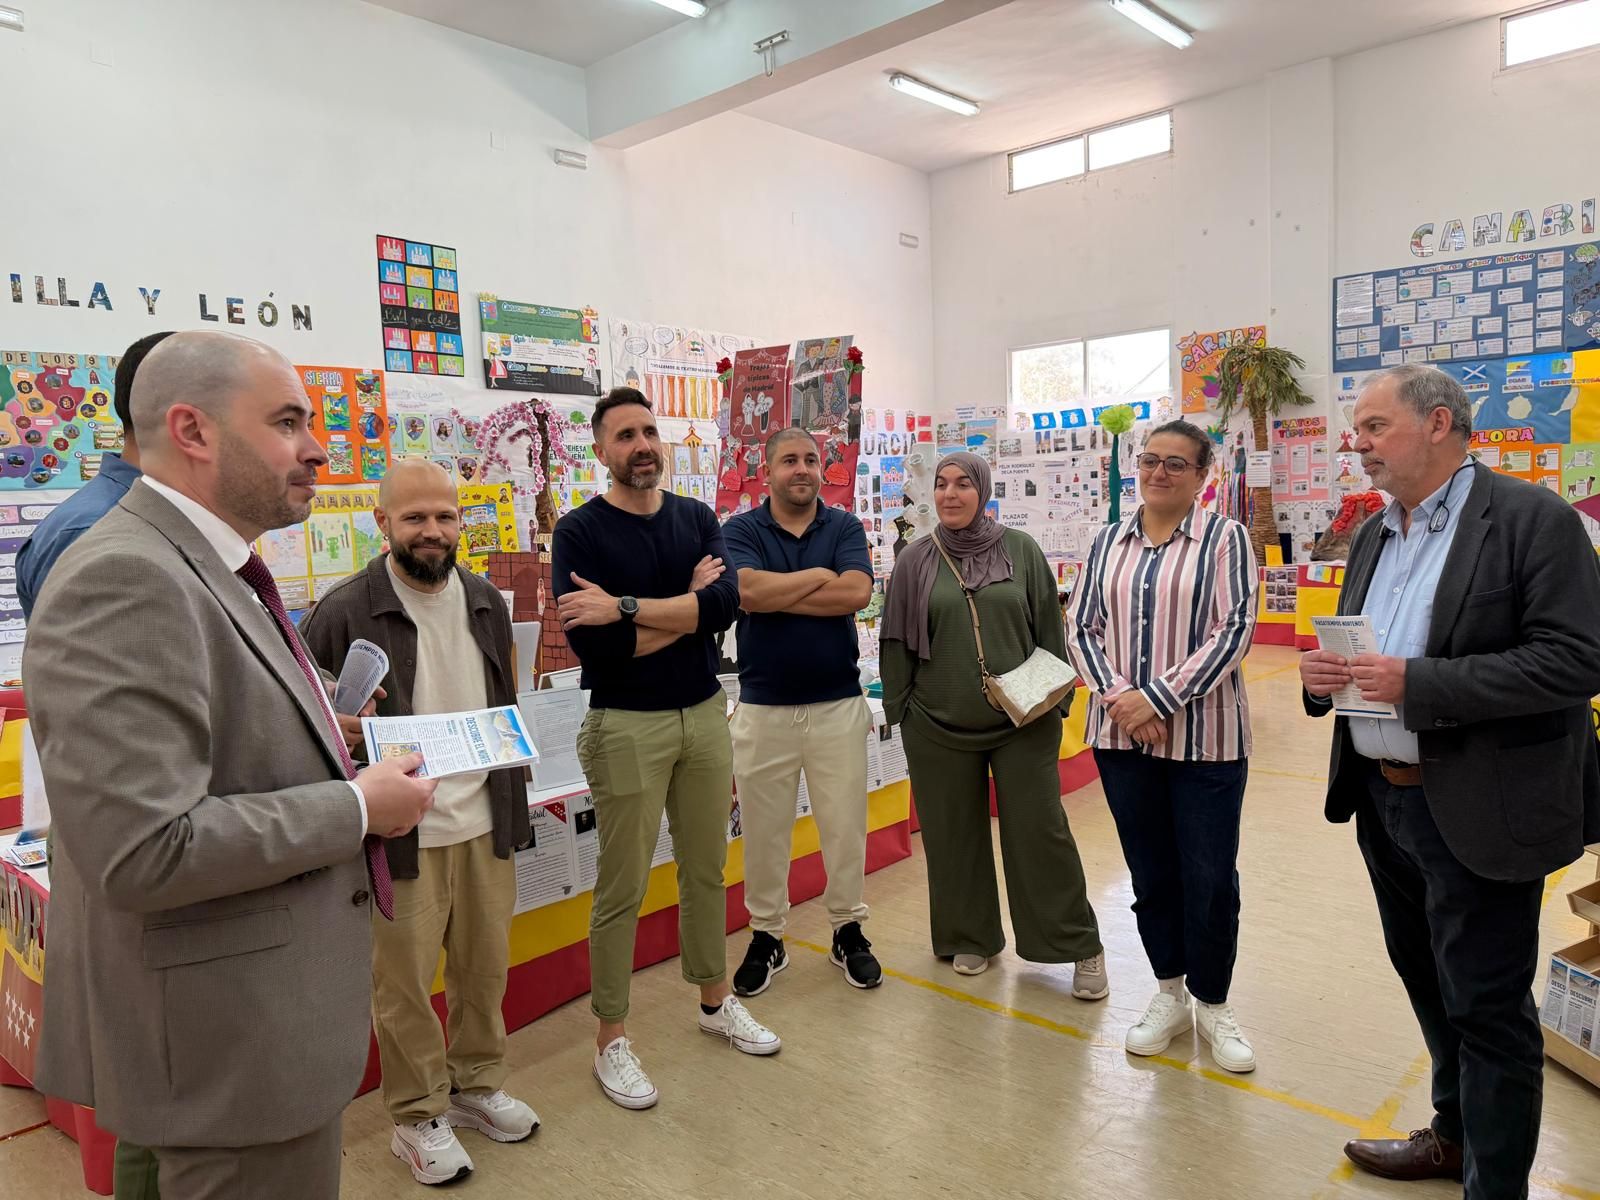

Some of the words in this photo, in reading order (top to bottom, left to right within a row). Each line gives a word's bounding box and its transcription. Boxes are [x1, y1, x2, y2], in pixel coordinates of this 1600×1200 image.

[1410, 198, 1596, 257] CANARI
[1496, 252, 1535, 264] Manrique
[10, 273, 114, 311] ILLA
[138, 287, 161, 316] Y
[198, 291, 313, 331] LEÓN
[5, 352, 28, 363] DE
[40, 354, 76, 365] LOS
[88, 356, 96, 366] 9
[750, 364, 770, 372] Trajes
[304, 370, 344, 387] SIERRA
[751, 384, 774, 392] Madrid
[1273, 417, 1320, 430] PLATOS
[1470, 427, 1535, 445] FLORA
[864, 432, 917, 456] URCIA
[316, 495, 374, 504] YENDA
[1003, 513, 1021, 521] PLAZA
[465, 716, 483, 744] DESCUBRE
[528, 808, 546, 821] adrid
[1570, 990, 1593, 1004] DESCUBRE
